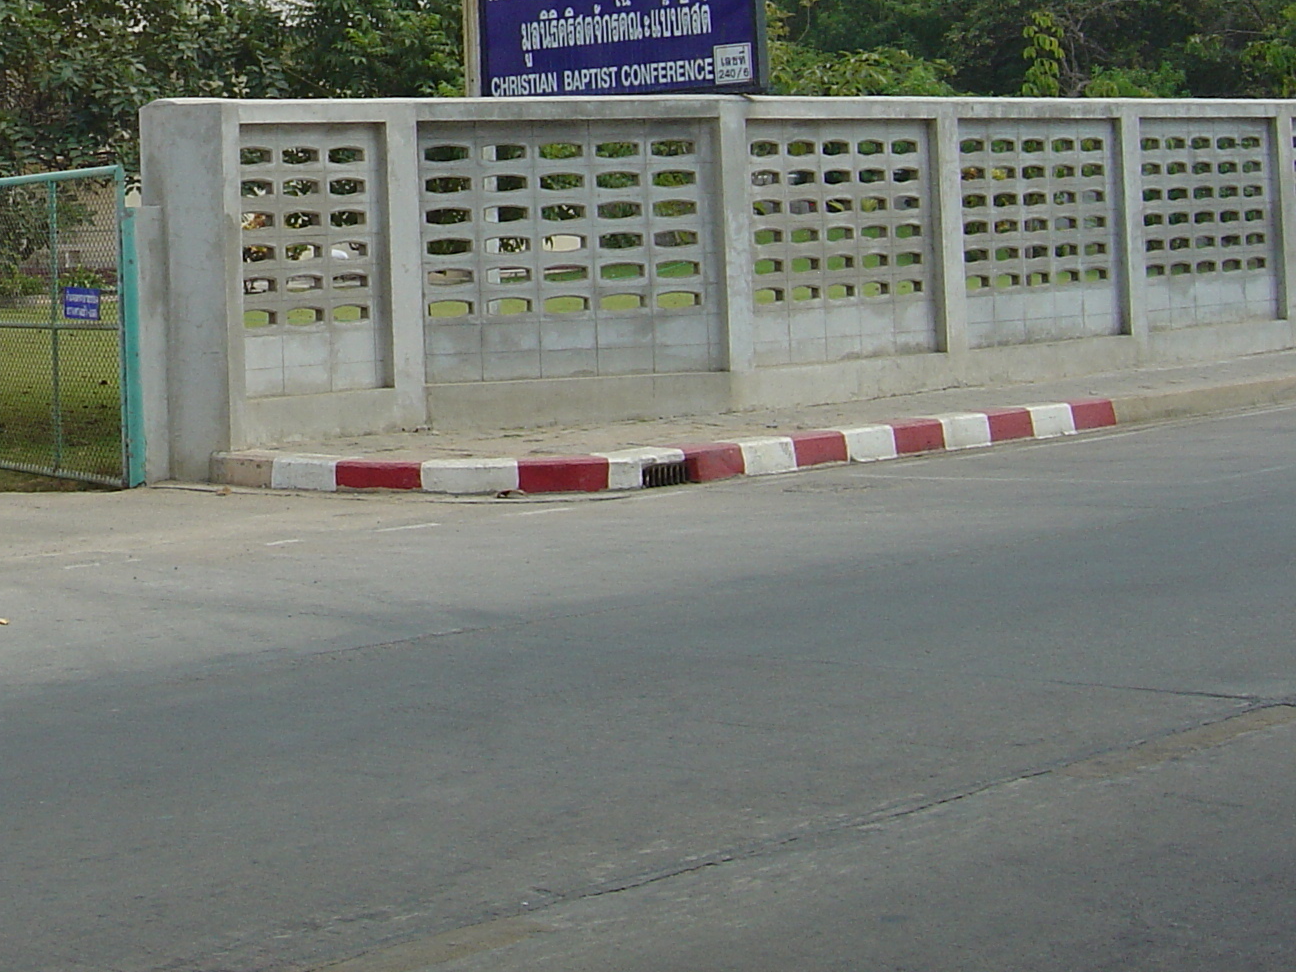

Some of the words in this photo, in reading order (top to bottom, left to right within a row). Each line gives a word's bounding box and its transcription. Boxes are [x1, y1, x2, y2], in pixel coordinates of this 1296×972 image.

[491, 73, 558, 97] CHRISTIAN
[564, 66, 617, 91] BAPTIST
[621, 58, 714, 87] CONFERENCE
[718, 67, 750, 80] 240/6
